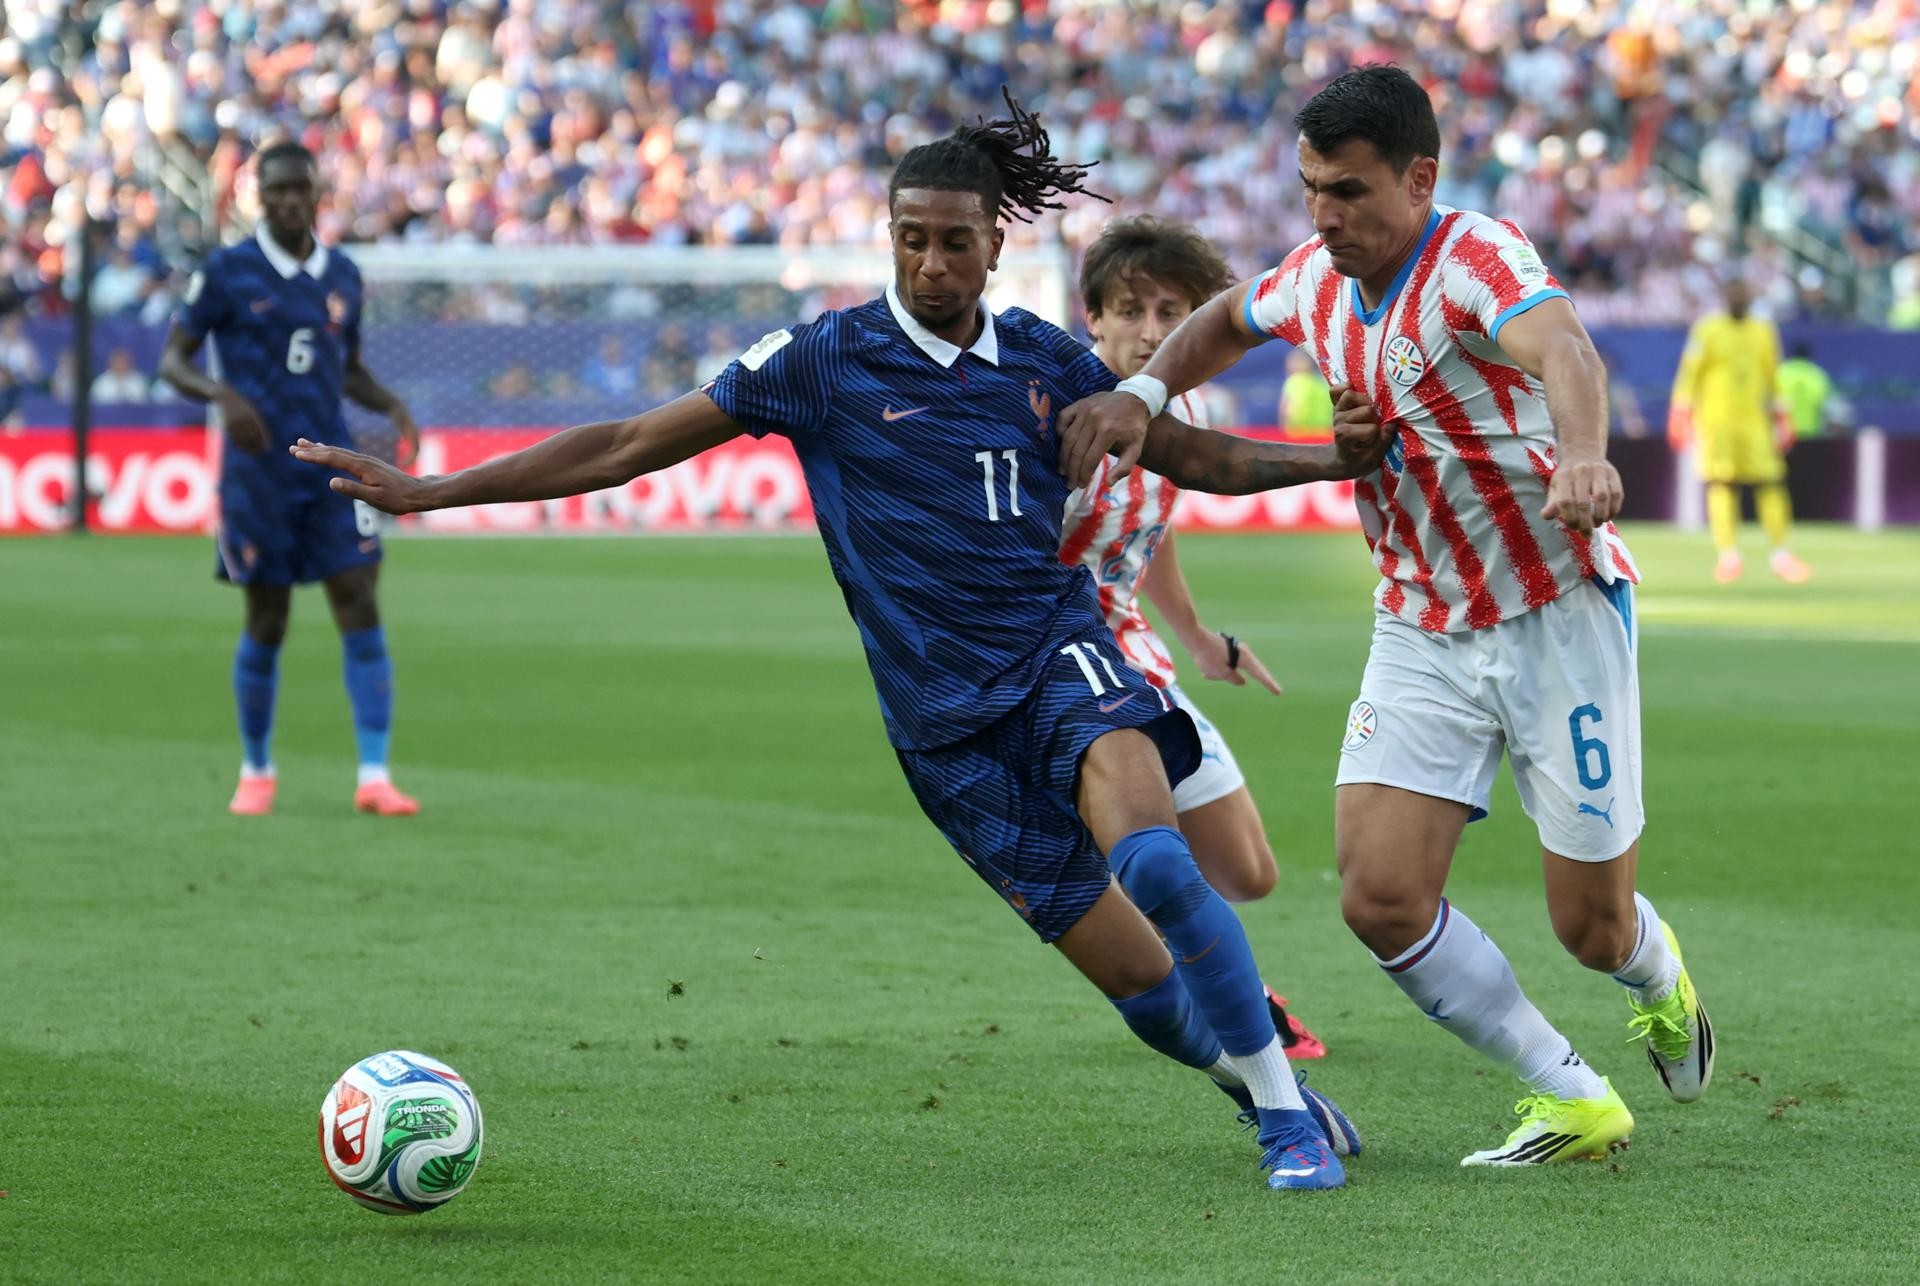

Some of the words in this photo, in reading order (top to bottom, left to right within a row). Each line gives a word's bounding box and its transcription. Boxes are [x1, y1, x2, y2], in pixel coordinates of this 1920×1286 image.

[287, 328, 314, 374] 6
[417, 434, 798, 532] Lovo
[975, 449, 1024, 521] 11
[1060, 642, 1124, 697] 11
[1569, 702, 1612, 791] 6
[396, 1104, 448, 1115] TRIONDA
